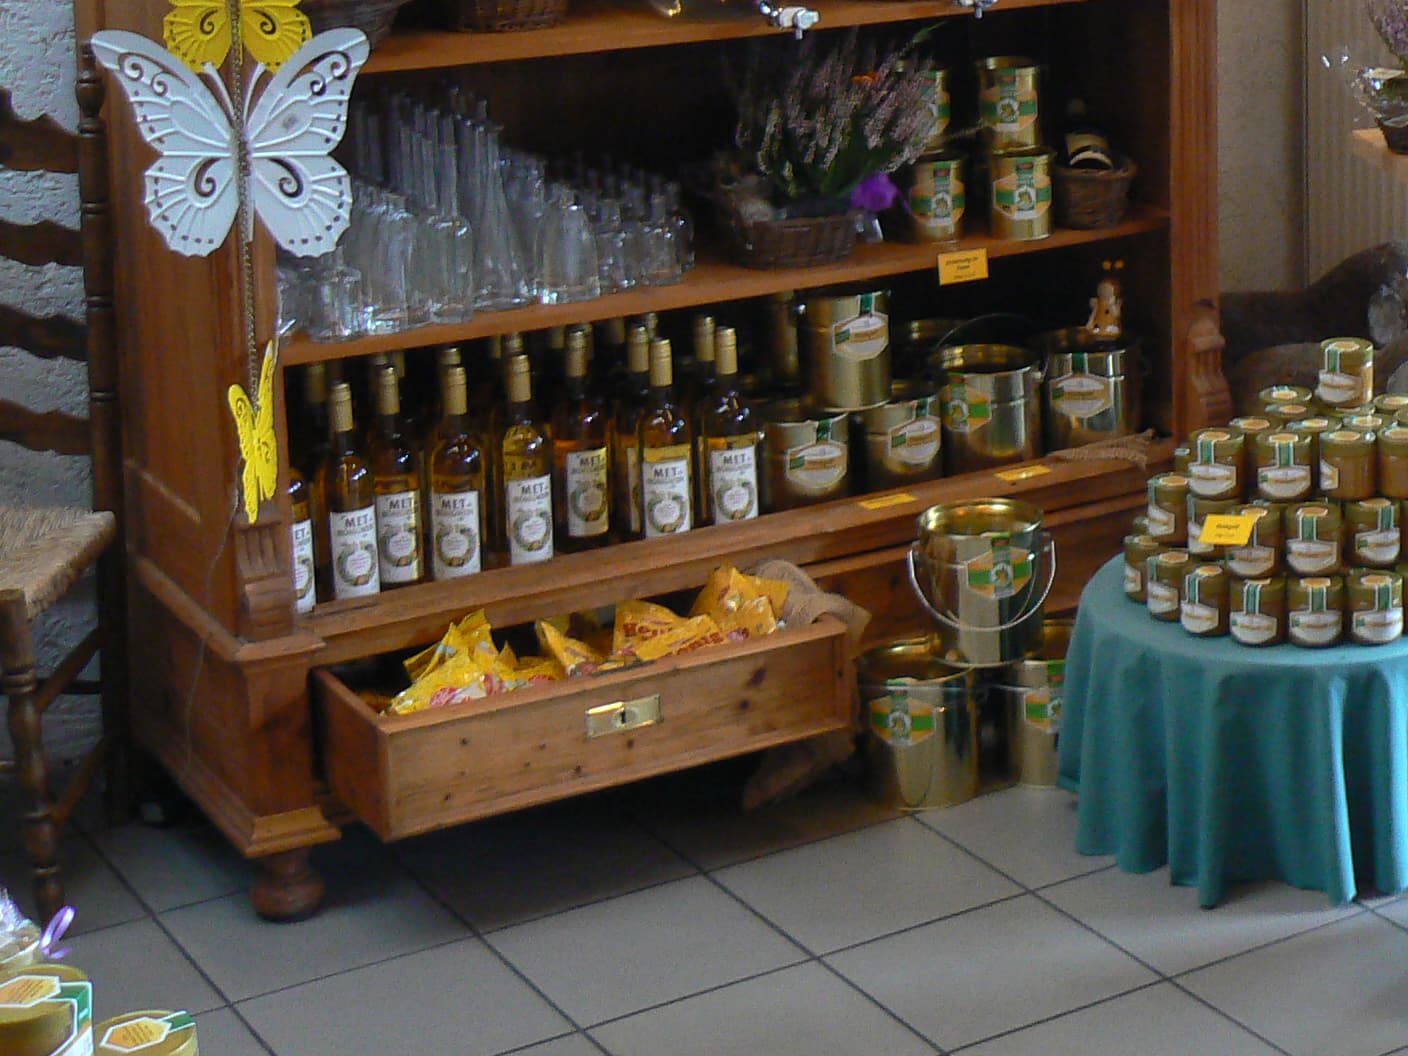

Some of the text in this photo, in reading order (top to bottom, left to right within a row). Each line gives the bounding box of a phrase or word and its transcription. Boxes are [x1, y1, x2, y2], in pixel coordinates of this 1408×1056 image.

[521, 482, 545, 495] MET
[389, 497, 413, 510] MET
[441, 498, 467, 510] MET
[344, 513, 369, 528] MET
